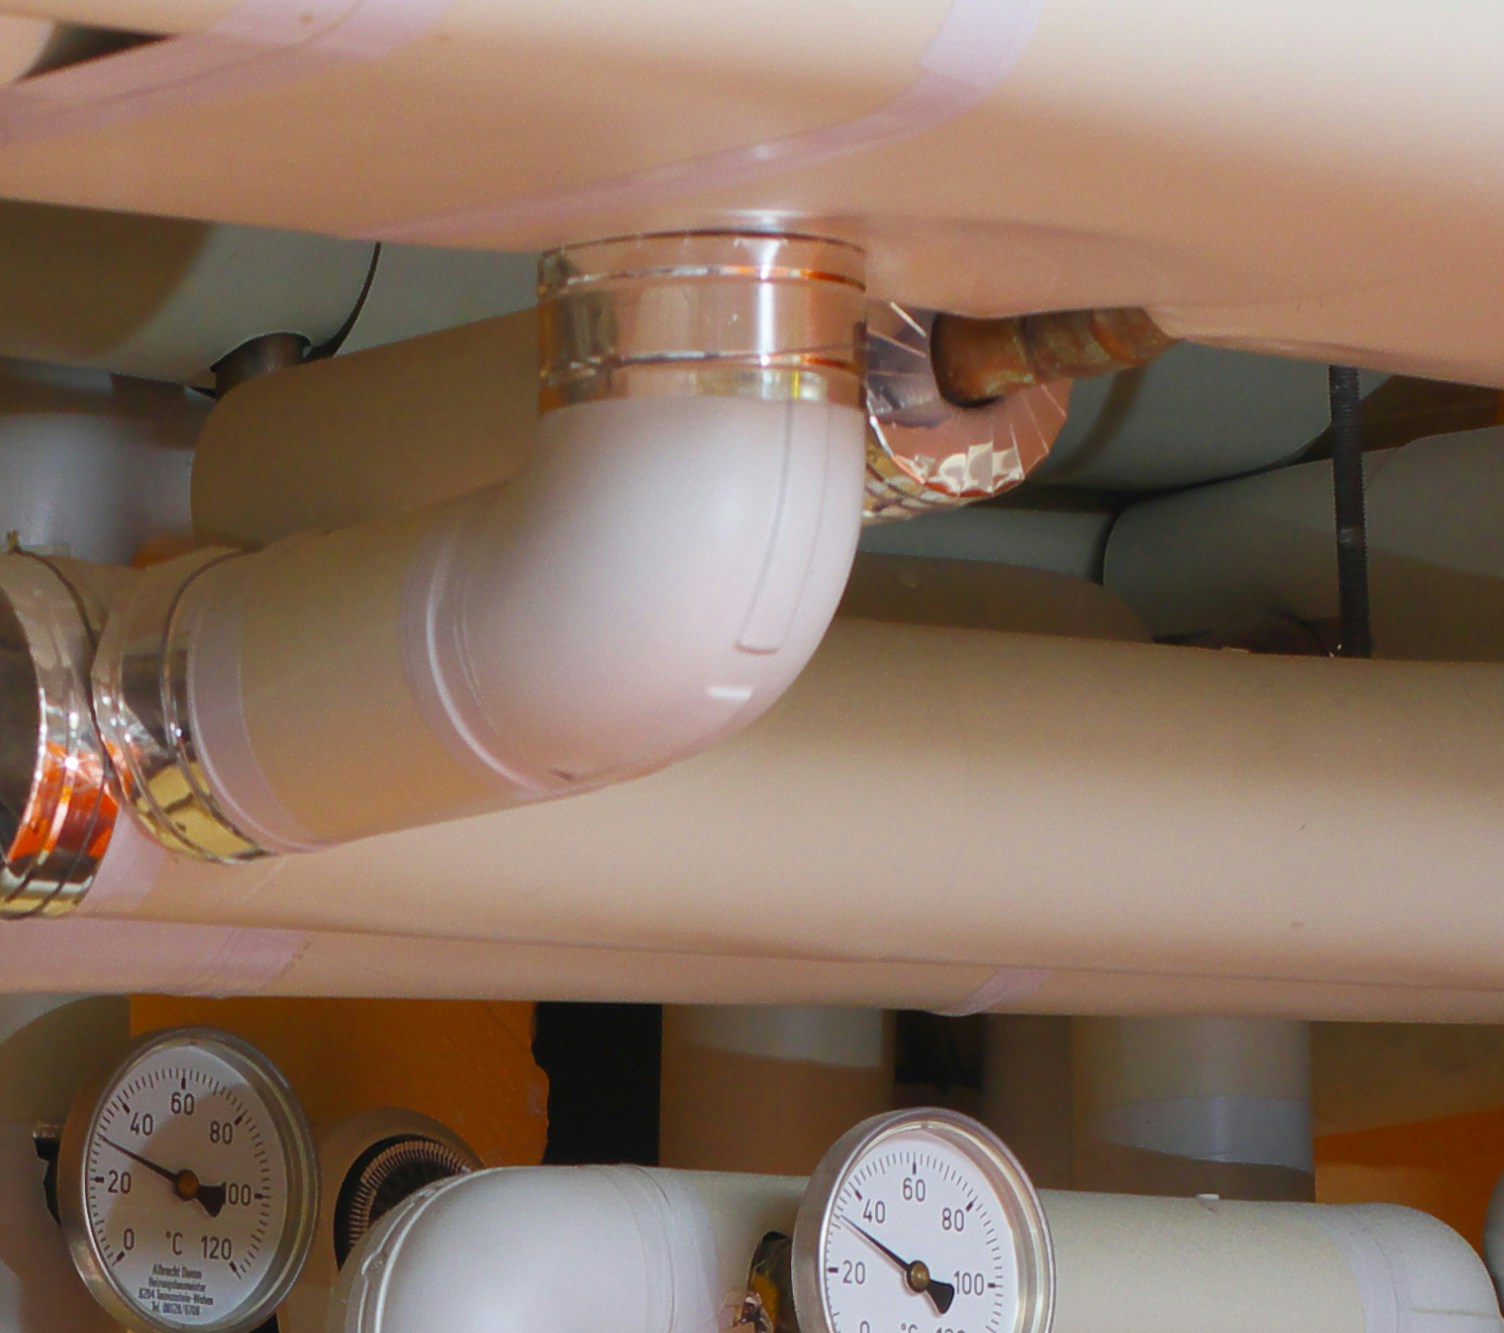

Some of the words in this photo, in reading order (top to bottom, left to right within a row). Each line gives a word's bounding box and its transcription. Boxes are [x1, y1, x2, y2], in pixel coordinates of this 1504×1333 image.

[171, 1092, 195, 1115] 60
[129, 1113, 153, 1136] 40
[209, 1121, 233, 1145] 80
[107, 1171, 131, 1194] 20
[902, 1177, 926, 1202] 60
[862, 1200, 886, 1224] 40
[941, 1207, 965, 1232] 80
[123, 1228, 135, 1250] 0
[165, 1231, 183, 1255] °C
[201, 1236, 232, 1261] 120
[842, 1260, 866, 1285] 20
[954, 1270, 985, 1296] 100
